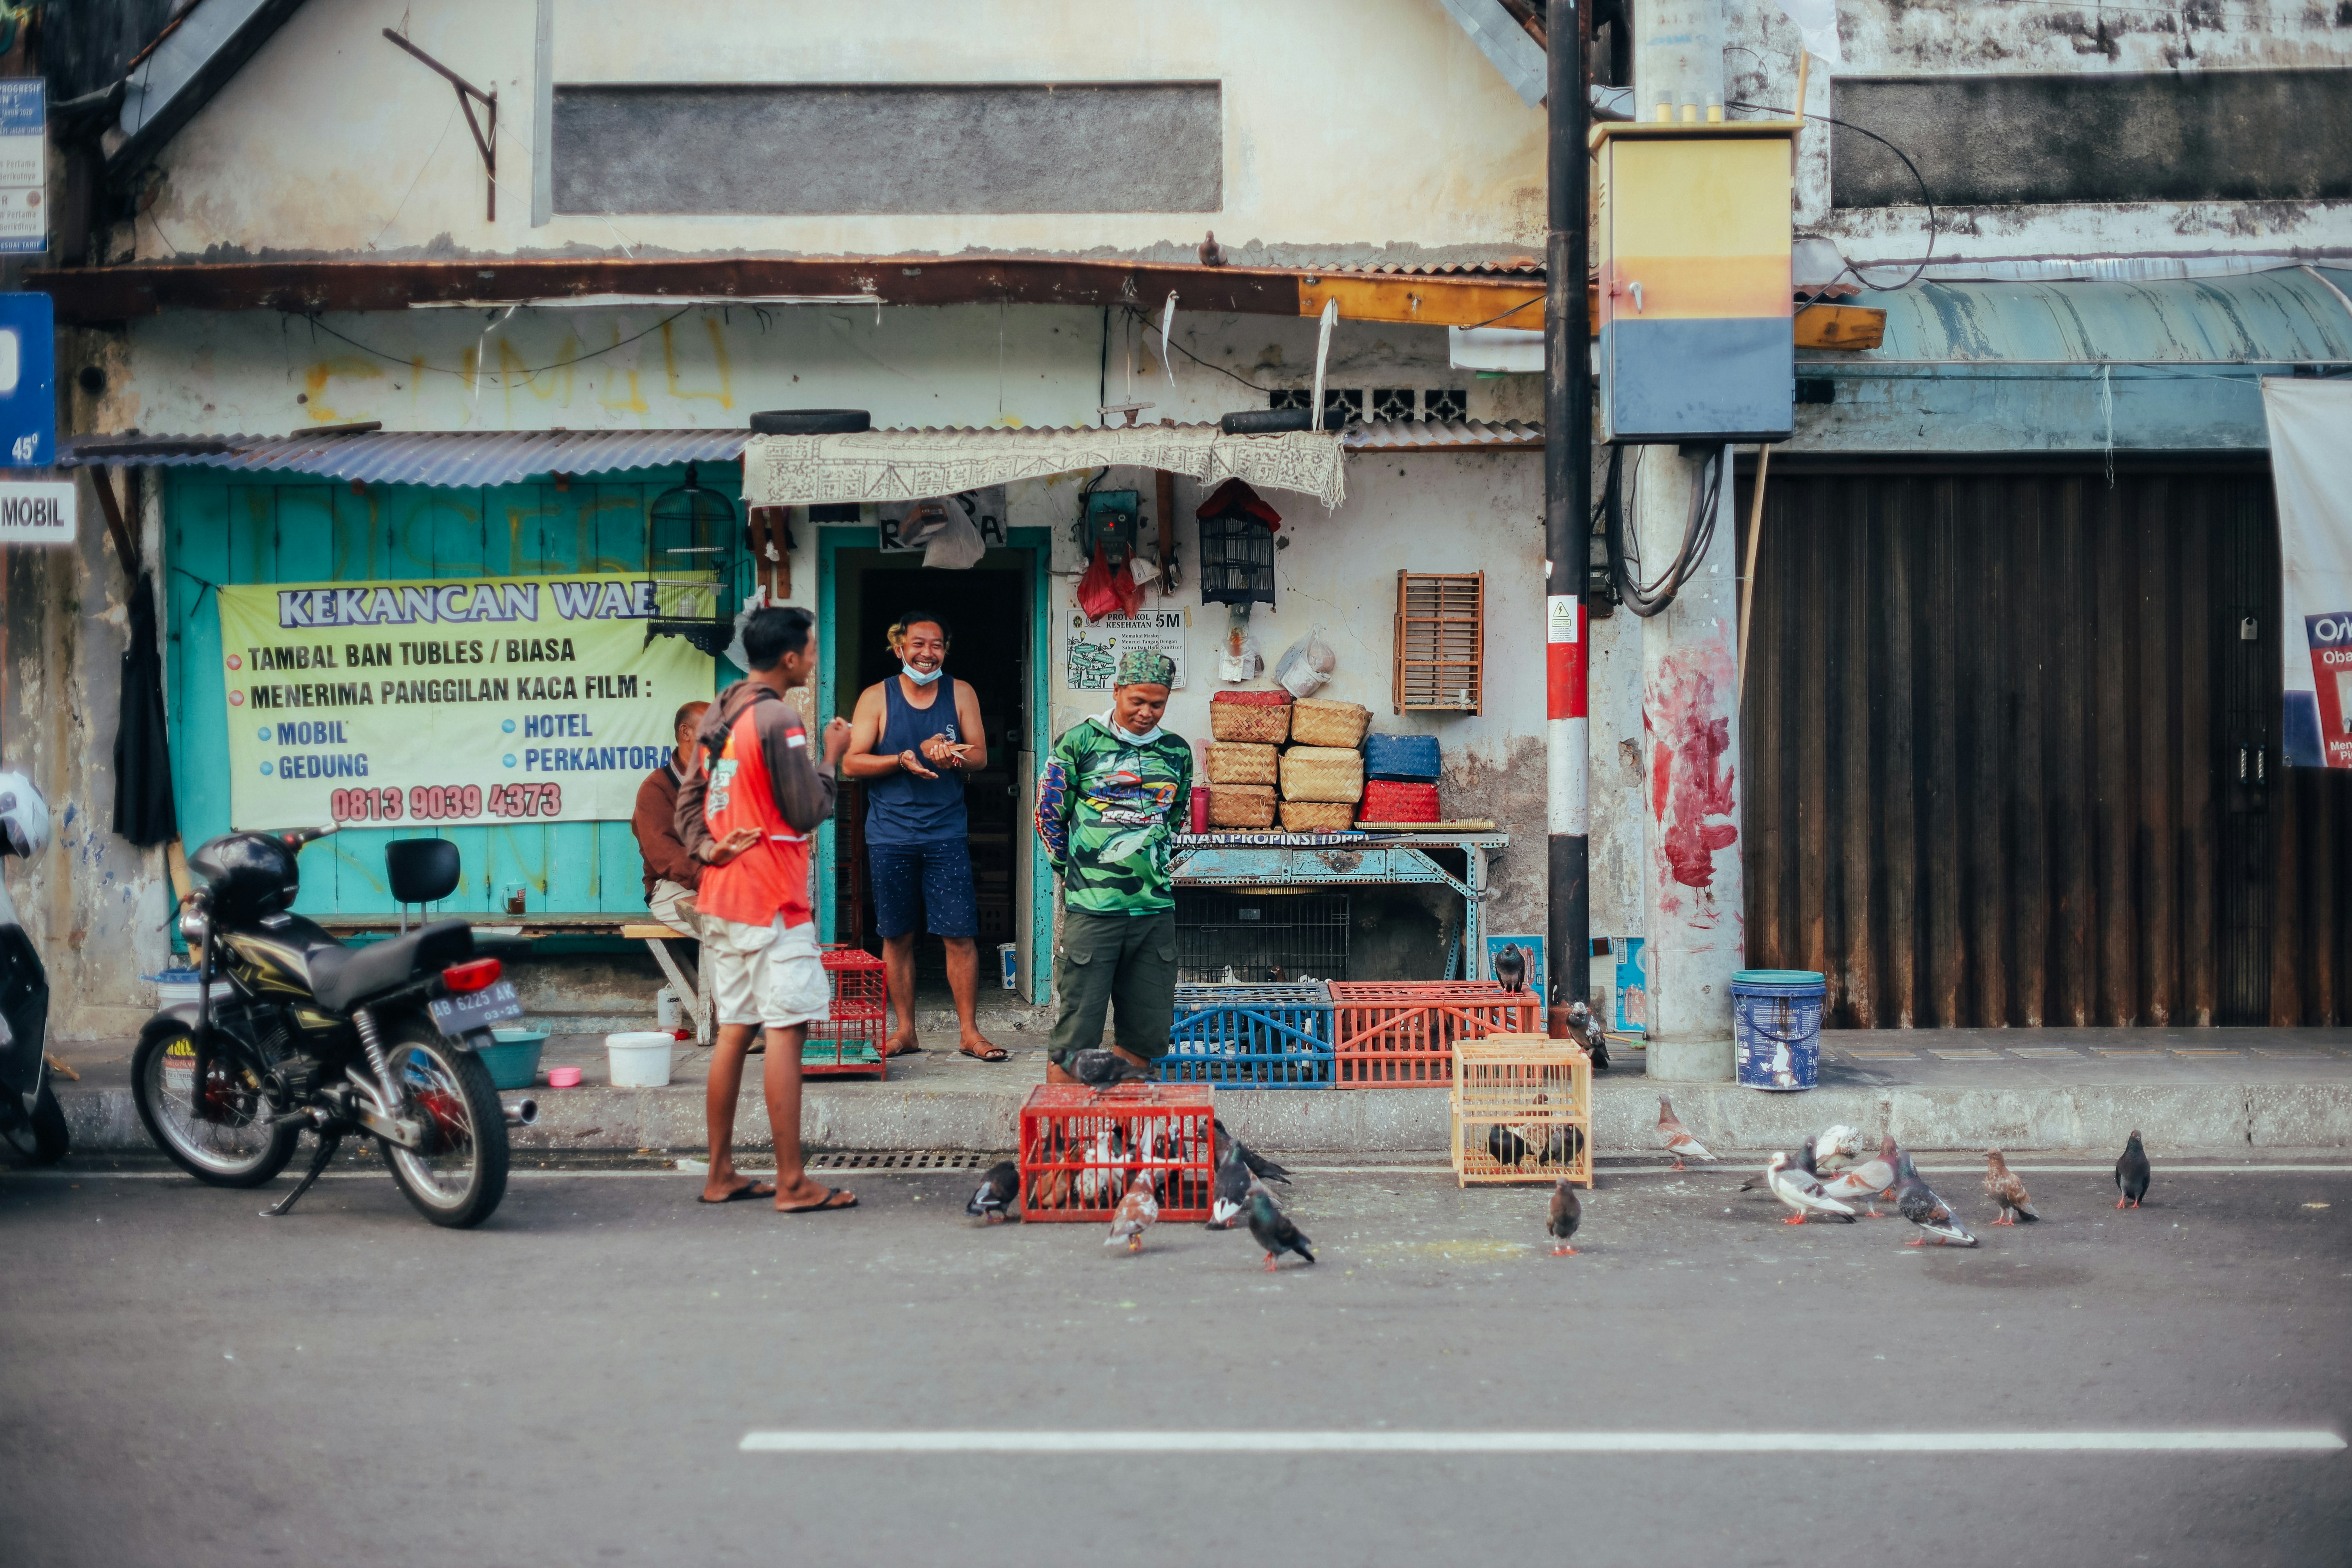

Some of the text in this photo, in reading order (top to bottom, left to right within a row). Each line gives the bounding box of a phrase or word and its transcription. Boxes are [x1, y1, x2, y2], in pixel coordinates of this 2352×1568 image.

[0, 84, 41, 93] ROGRESIF
[7, 211, 36, 219] Pertama
[1, 496, 64, 527] MOBIL
[277, 583, 539, 628] KEKANCAN
[248, 645, 338, 671] TAMBAL
[345, 642, 392, 667] BAN
[399, 640, 483, 666] TUBLES
[506, 638, 576, 663] BIASA
[250, 681, 374, 709] MENERIMA
[381, 678, 509, 704] PANGGILAN
[517, 676, 579, 701] KACA
[585, 675, 637, 699] FILM
[277, 714, 593, 745] MOBIL HOTEL
[279, 746, 678, 779] GEDUNG PERKANTORA
[331, 782, 561, 822] 0813 9039 4373
[1230, 834, 1316, 845] PROPINSI
[434, 983, 515, 1018] AB 6225 AK
